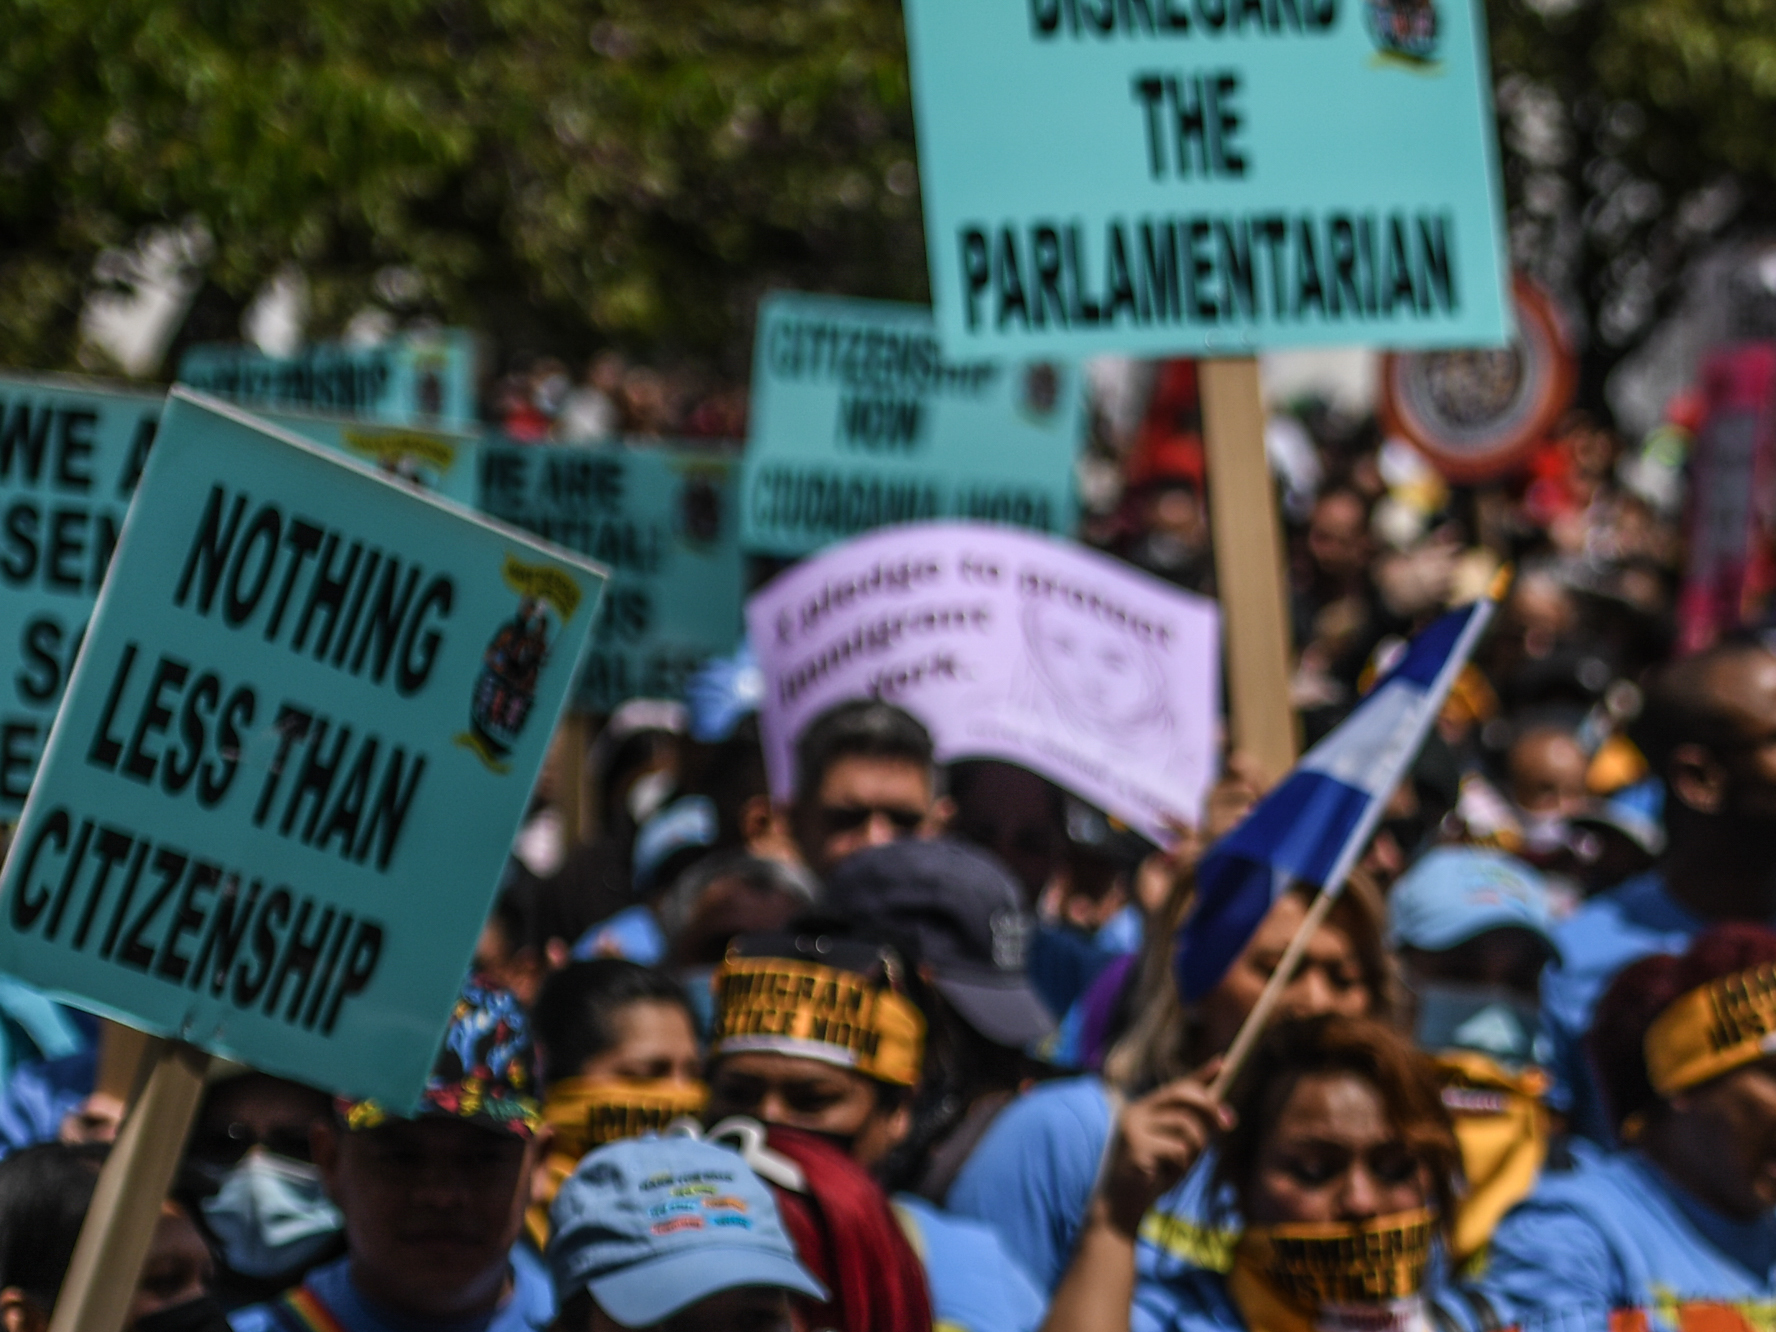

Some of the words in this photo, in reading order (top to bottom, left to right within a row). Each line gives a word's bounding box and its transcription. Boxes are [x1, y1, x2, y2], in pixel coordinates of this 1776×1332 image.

[1132, 68, 1251, 181] THE
[956, 208, 1462, 334] PARLAMENTARIAN
[173, 484, 454, 695] NOTHING
[85, 640, 257, 809] LESS
[252, 702, 427, 875] THAN
[8, 806, 385, 1039] CITIZENSHIP
